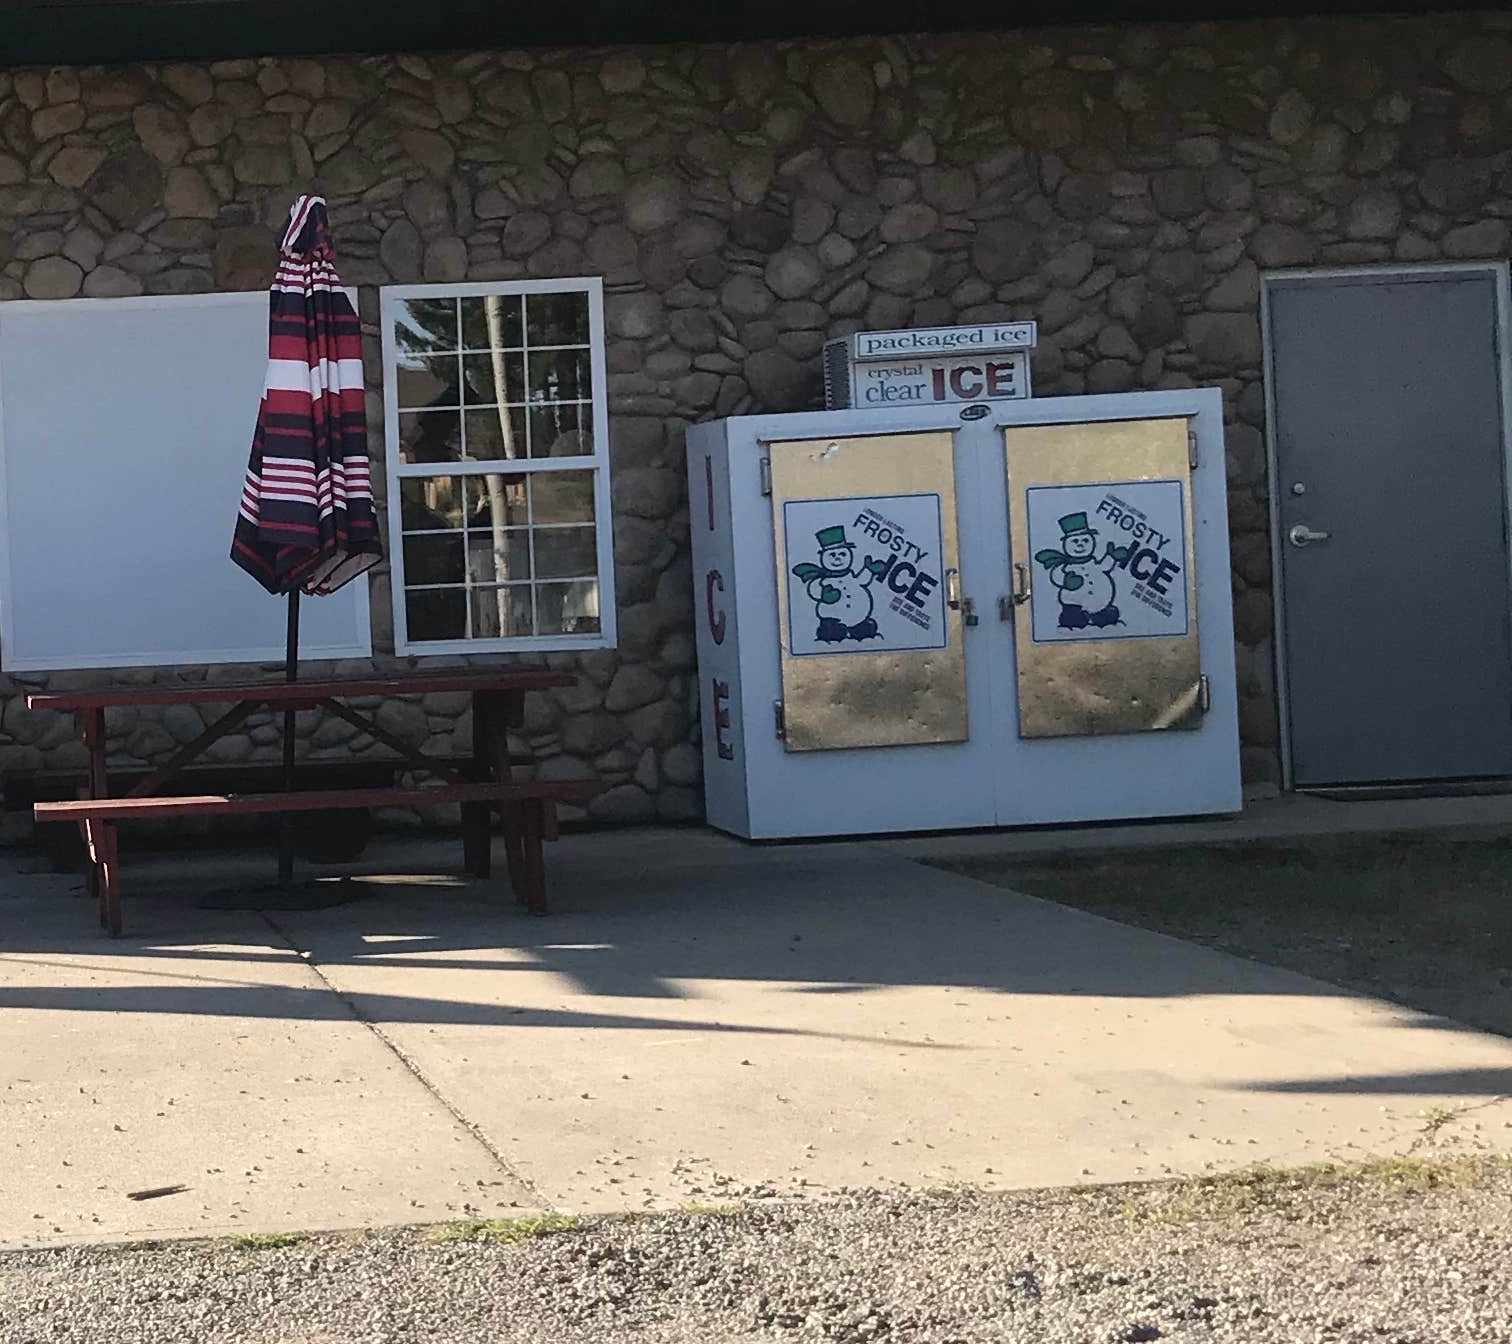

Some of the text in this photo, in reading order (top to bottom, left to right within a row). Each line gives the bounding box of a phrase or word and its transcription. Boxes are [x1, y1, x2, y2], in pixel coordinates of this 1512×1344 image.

[867, 328, 1028, 354] packaged ice
[865, 358, 1017, 403] clear ICE
[867, 364, 923, 381] crystal
[852, 512, 930, 564] FROSTY
[1095, 499, 1172, 551] FROSTY
[874, 553, 939, 609] ICE
[1117, 539, 1181, 596] ICE
[704, 453, 735, 761] ICE
